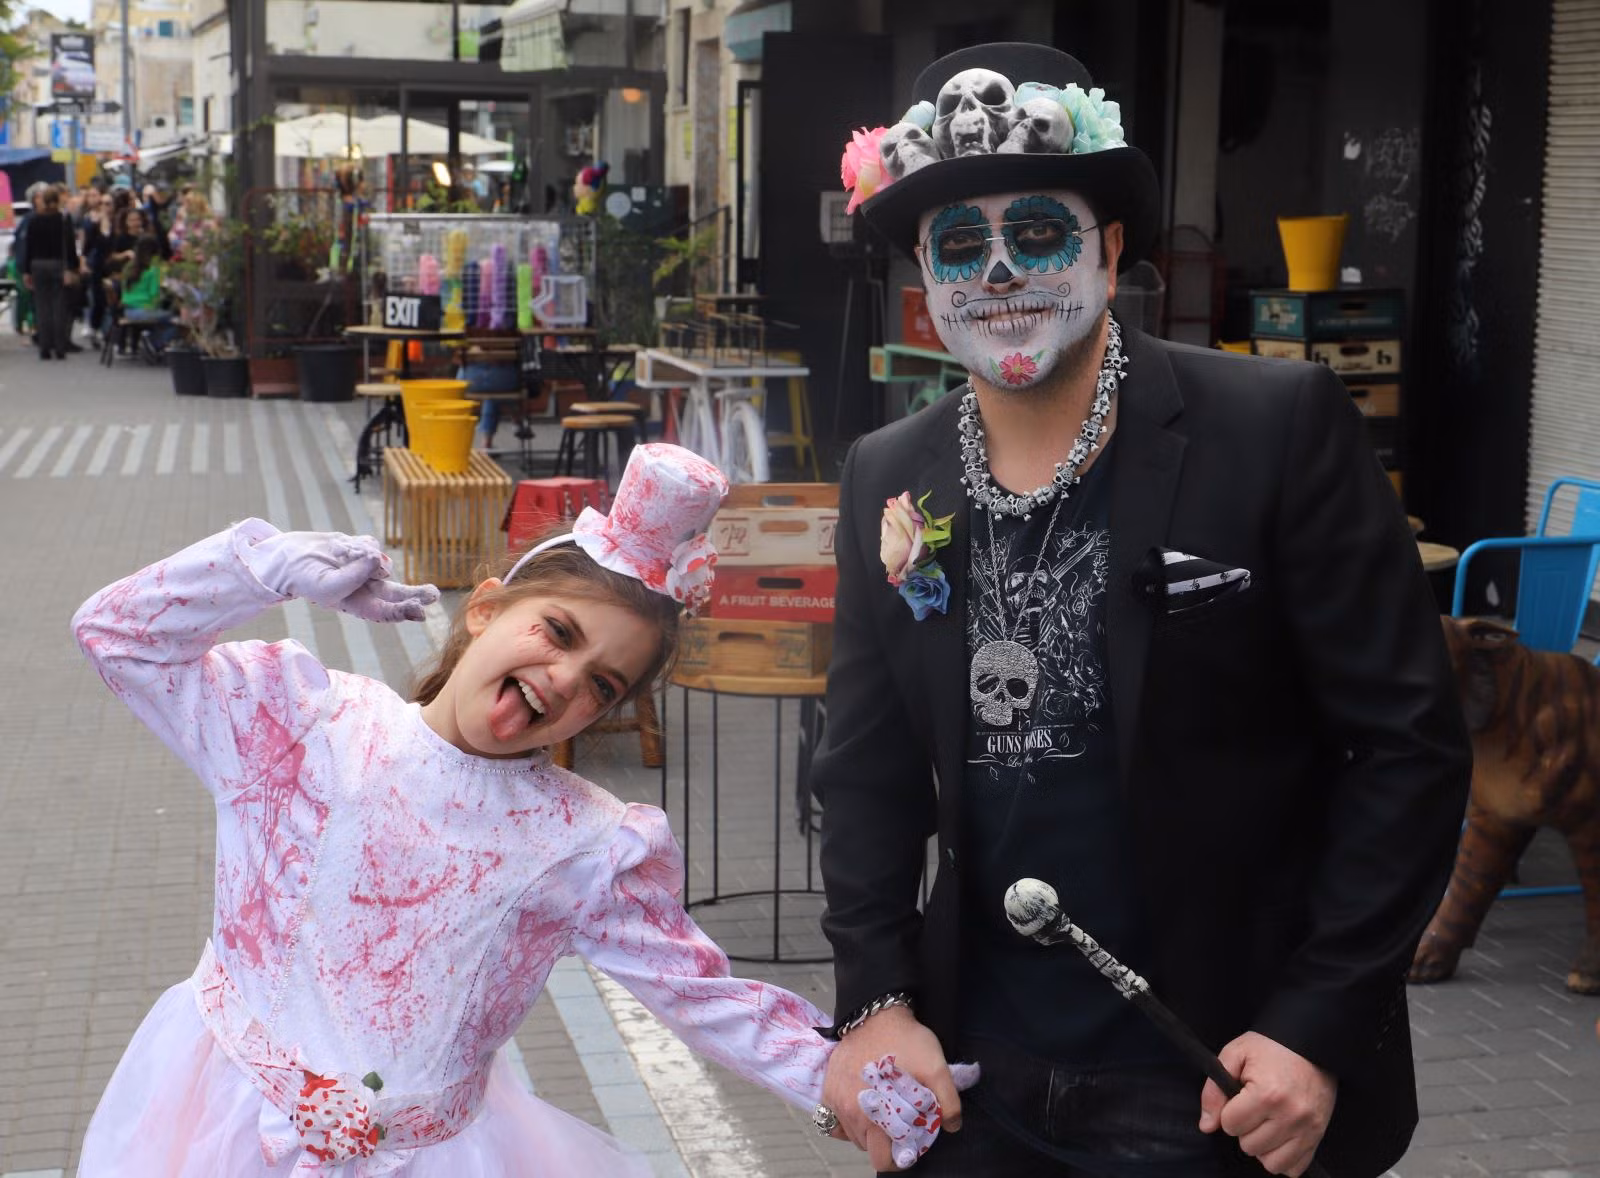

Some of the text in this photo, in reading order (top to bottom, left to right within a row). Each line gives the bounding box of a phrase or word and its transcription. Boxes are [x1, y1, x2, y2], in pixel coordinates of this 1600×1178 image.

[386, 296, 421, 327] EXIT
[719, 595, 835, 609] A FRUIT BEVERAGE
[988, 735, 1021, 753] GUNS
